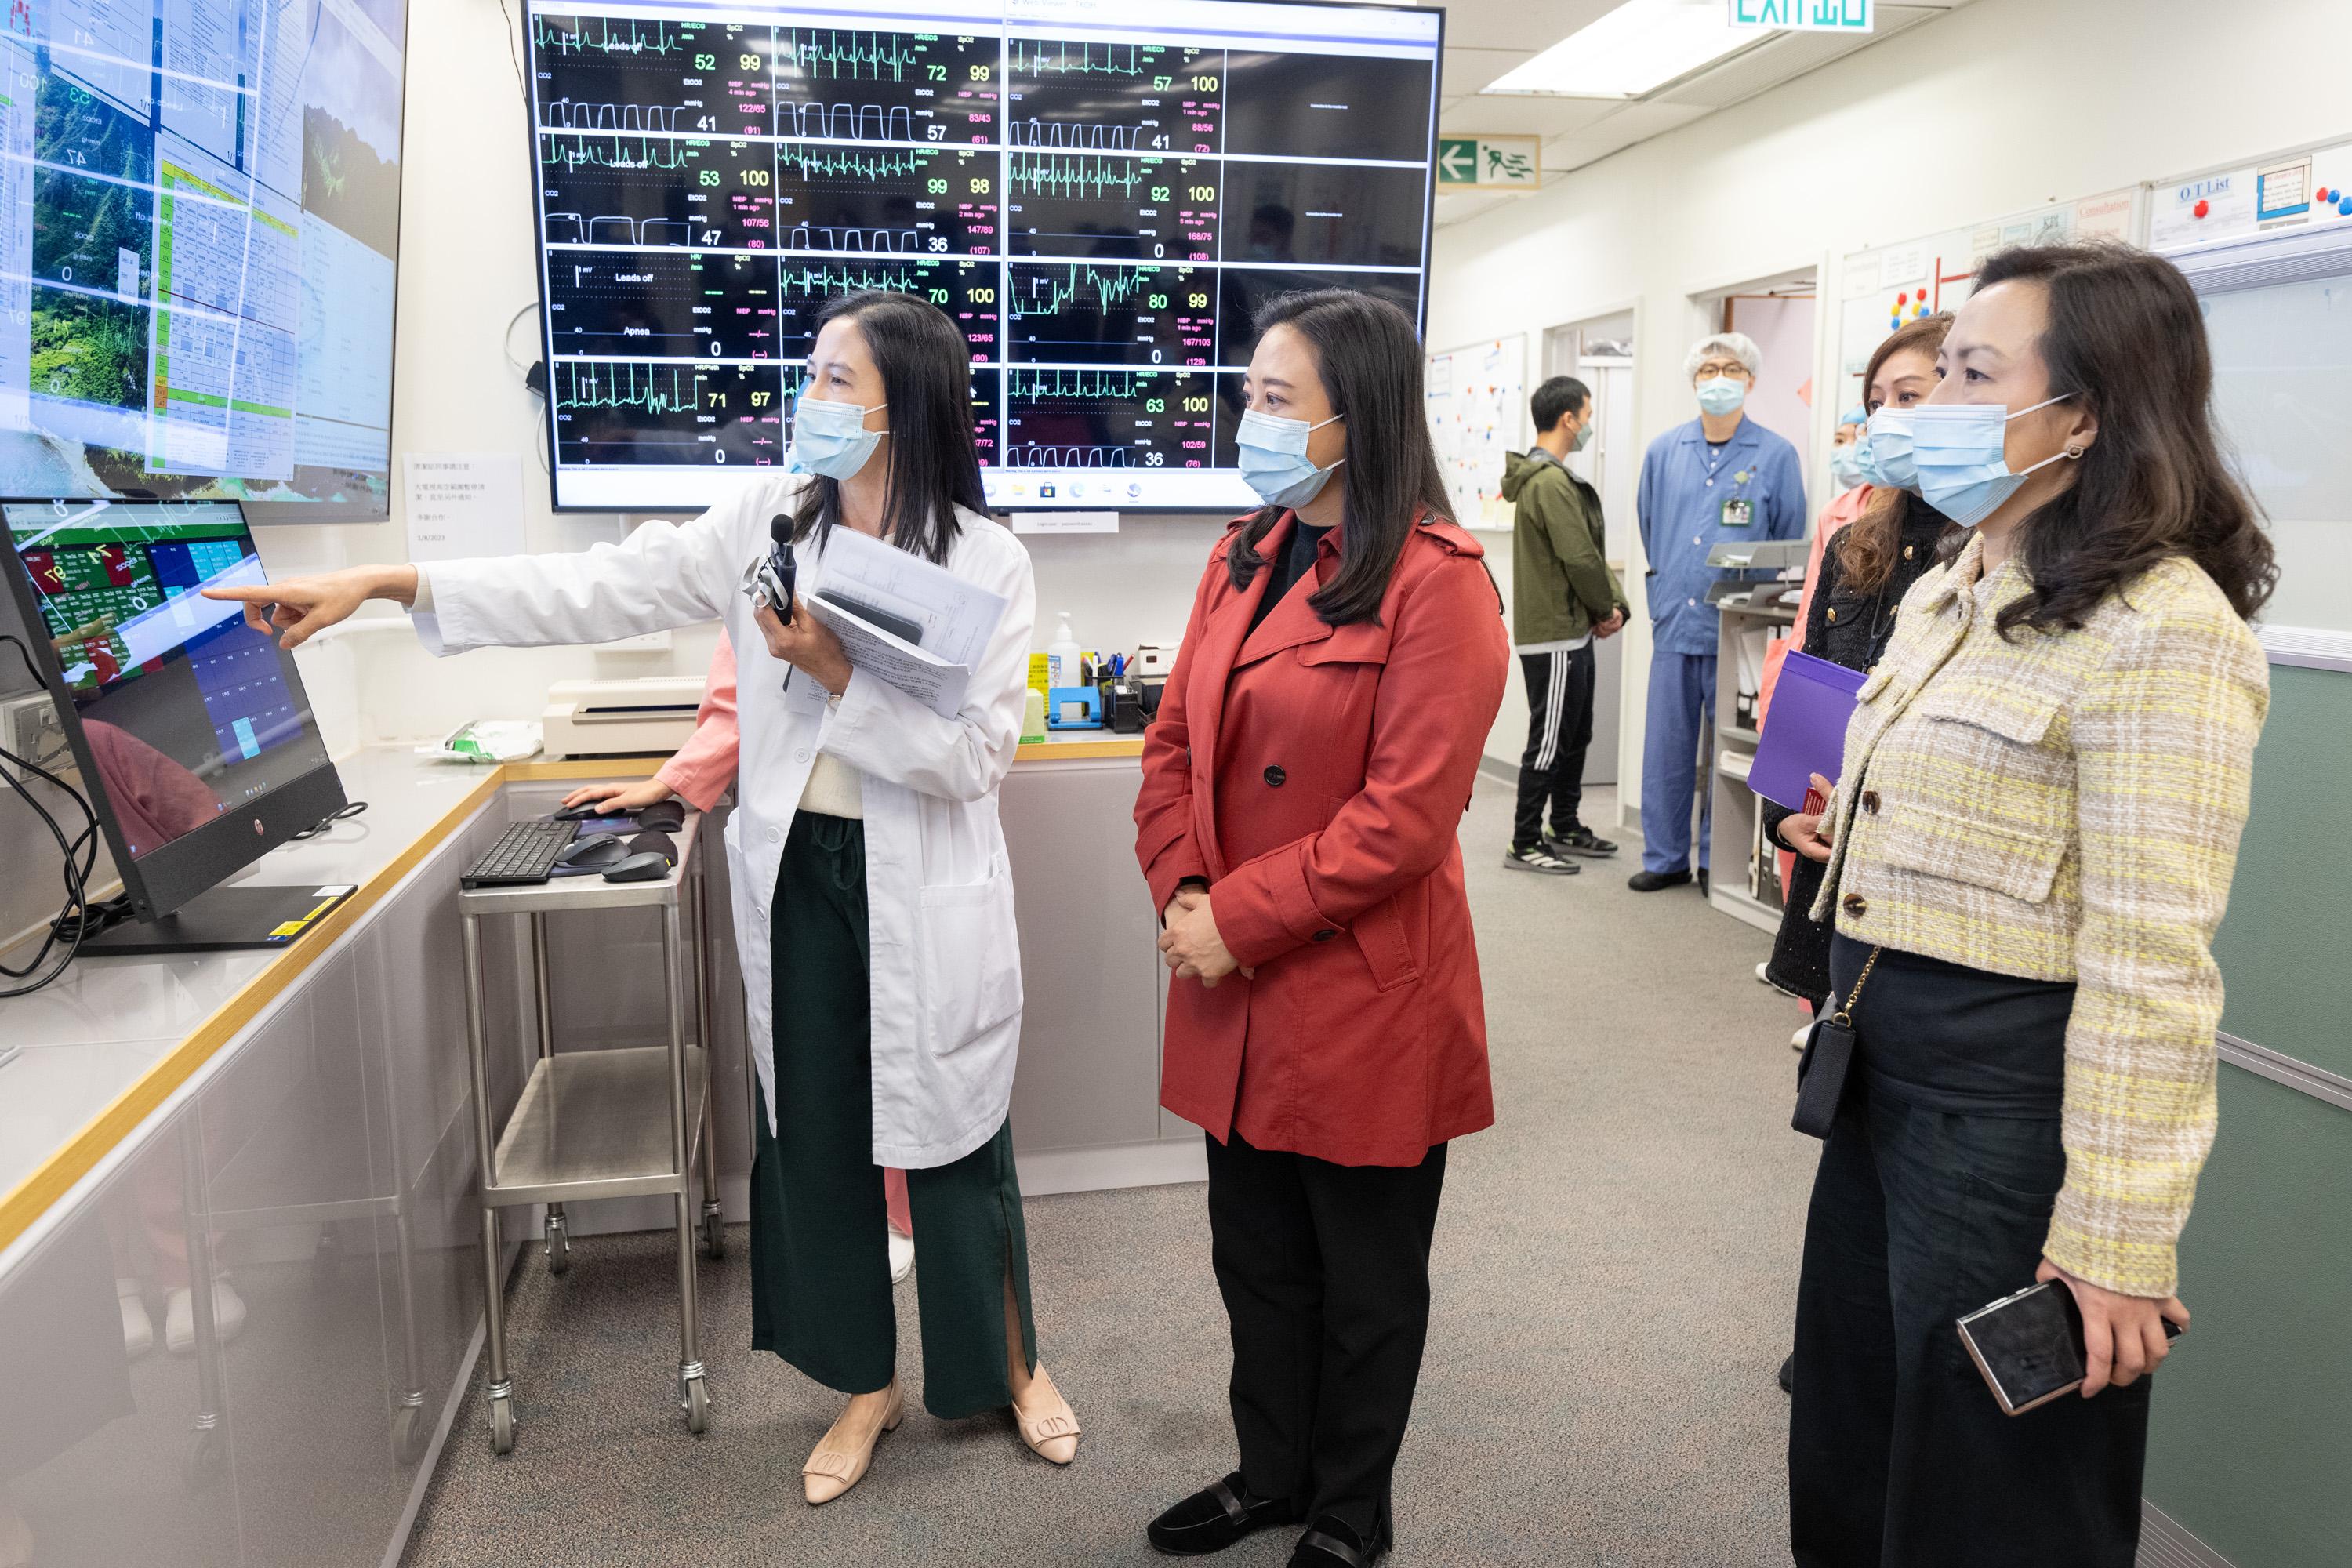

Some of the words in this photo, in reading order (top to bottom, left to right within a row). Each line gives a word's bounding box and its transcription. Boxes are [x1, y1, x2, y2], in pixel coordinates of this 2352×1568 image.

[695, 54, 715, 71] 52
[740, 55, 760, 71] 99
[927, 65, 946, 81] 72
[970, 66, 989, 81] 99
[1153, 76, 1172, 91] 57
[1191, 77, 1218, 92] 100
[739, 104, 765, 113] 122/65
[697, 116, 716, 131] 41
[969, 114, 991, 122] 83/43
[744, 126, 760, 135] (91)
[927, 125, 946, 140] 57
[1152, 135, 1169, 149] 41
[610, 159, 636, 168] Leads
[637, 159, 647, 168] off
[699, 171, 720, 186] 53
[740, 171, 768, 186] 100
[928, 179, 947, 194] 99
[971, 179, 989, 194] 98
[2181, 187, 2190, 200] O
[2196, 184, 2202, 195] T
[2208, 178, 2229, 194] List
[1151, 187, 1169, 201] 92
[1189, 187, 1214, 201] 100
[2079, 200, 2129, 217] Consultation
[702, 230, 721, 245] 47
[928, 237, 948, 252] 36
[1154, 244, 1164, 258] 0
[616, 274, 640, 282] Leads
[642, 274, 653, 282] off
[929, 289, 948, 303] 70
[967, 289, 994, 303] 100
[1149, 294, 1167, 309] 80
[1189, 294, 1207, 308] 99
[624, 327, 650, 336] Apnea
[711, 342, 721, 356] 0
[1152, 350, 1161, 363] 0
[1186, 358, 1206, 366] (129)
[708, 393, 726, 407] 71
[751, 392, 770, 406] 97
[1146, 399, 1164, 412] 63
[1182, 397, 1208, 412] 100
[715, 449, 725, 464] 0
[1145, 452, 1163, 466] 36
